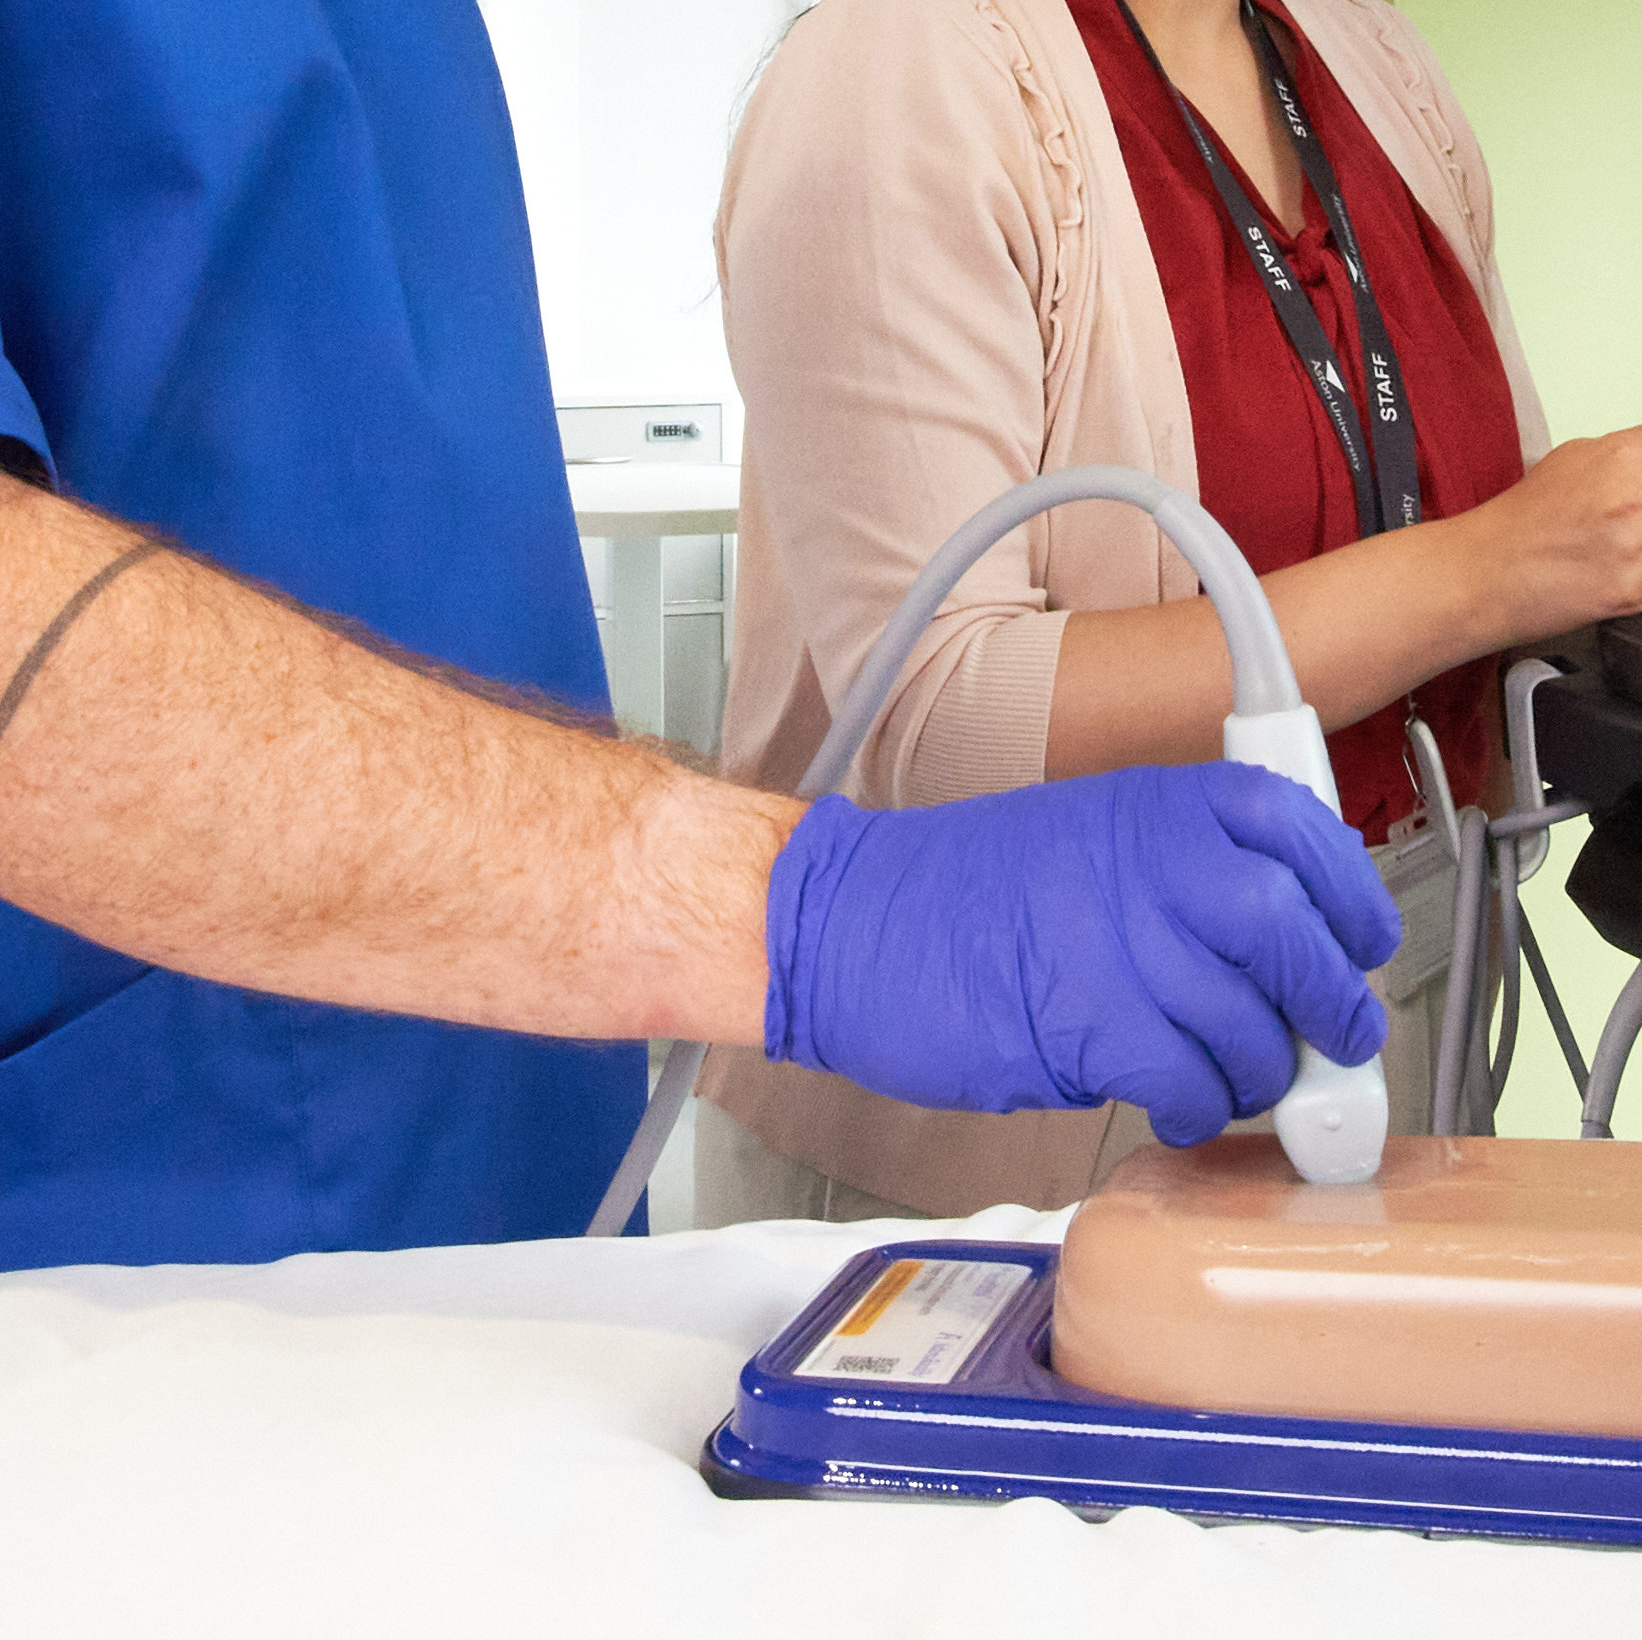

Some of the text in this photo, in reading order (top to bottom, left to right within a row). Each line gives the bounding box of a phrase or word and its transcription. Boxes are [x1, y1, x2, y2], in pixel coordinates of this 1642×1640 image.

[1274, 78, 1308, 138] STAFF
[1247, 226, 1292, 292] STAFF
[1310, 359, 1361, 472] Aston University
[1371, 352, 1398, 422] STAFF
